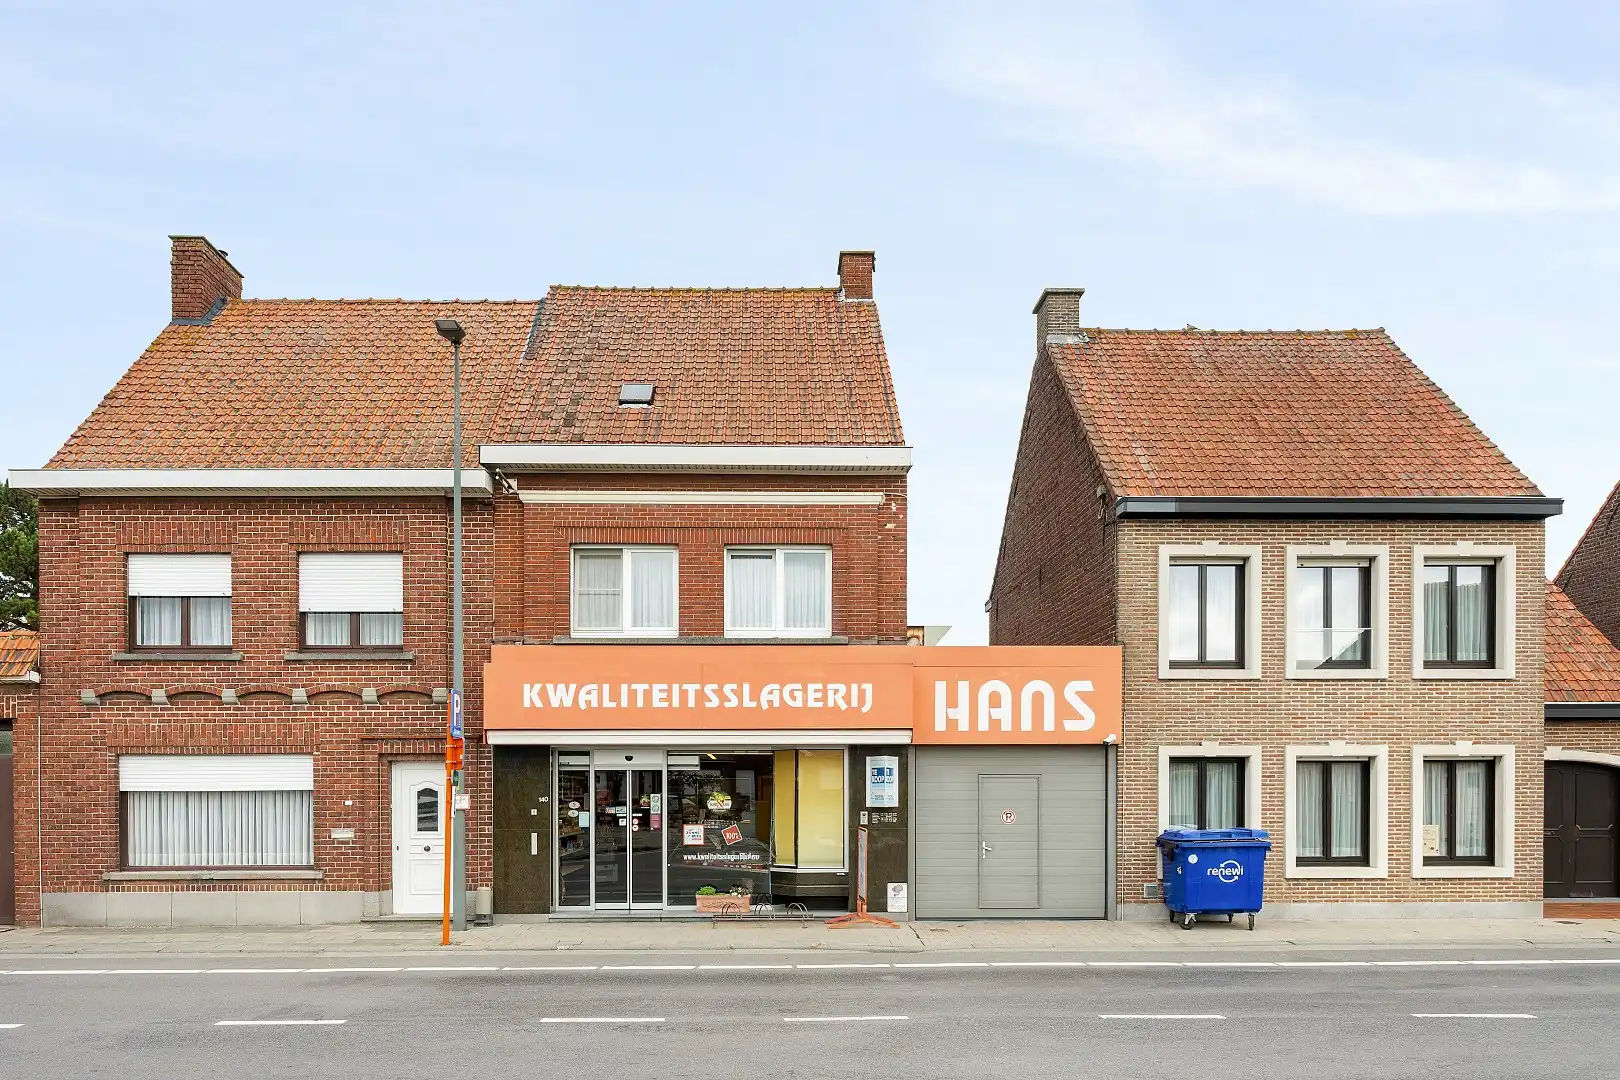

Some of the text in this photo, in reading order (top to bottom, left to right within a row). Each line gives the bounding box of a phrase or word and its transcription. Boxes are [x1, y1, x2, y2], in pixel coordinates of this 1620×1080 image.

[522, 683, 873, 713] KWALITEITSSLAGERIJ
[934, 680, 1096, 732] HANS
[1207, 866, 1244, 876] renewi
